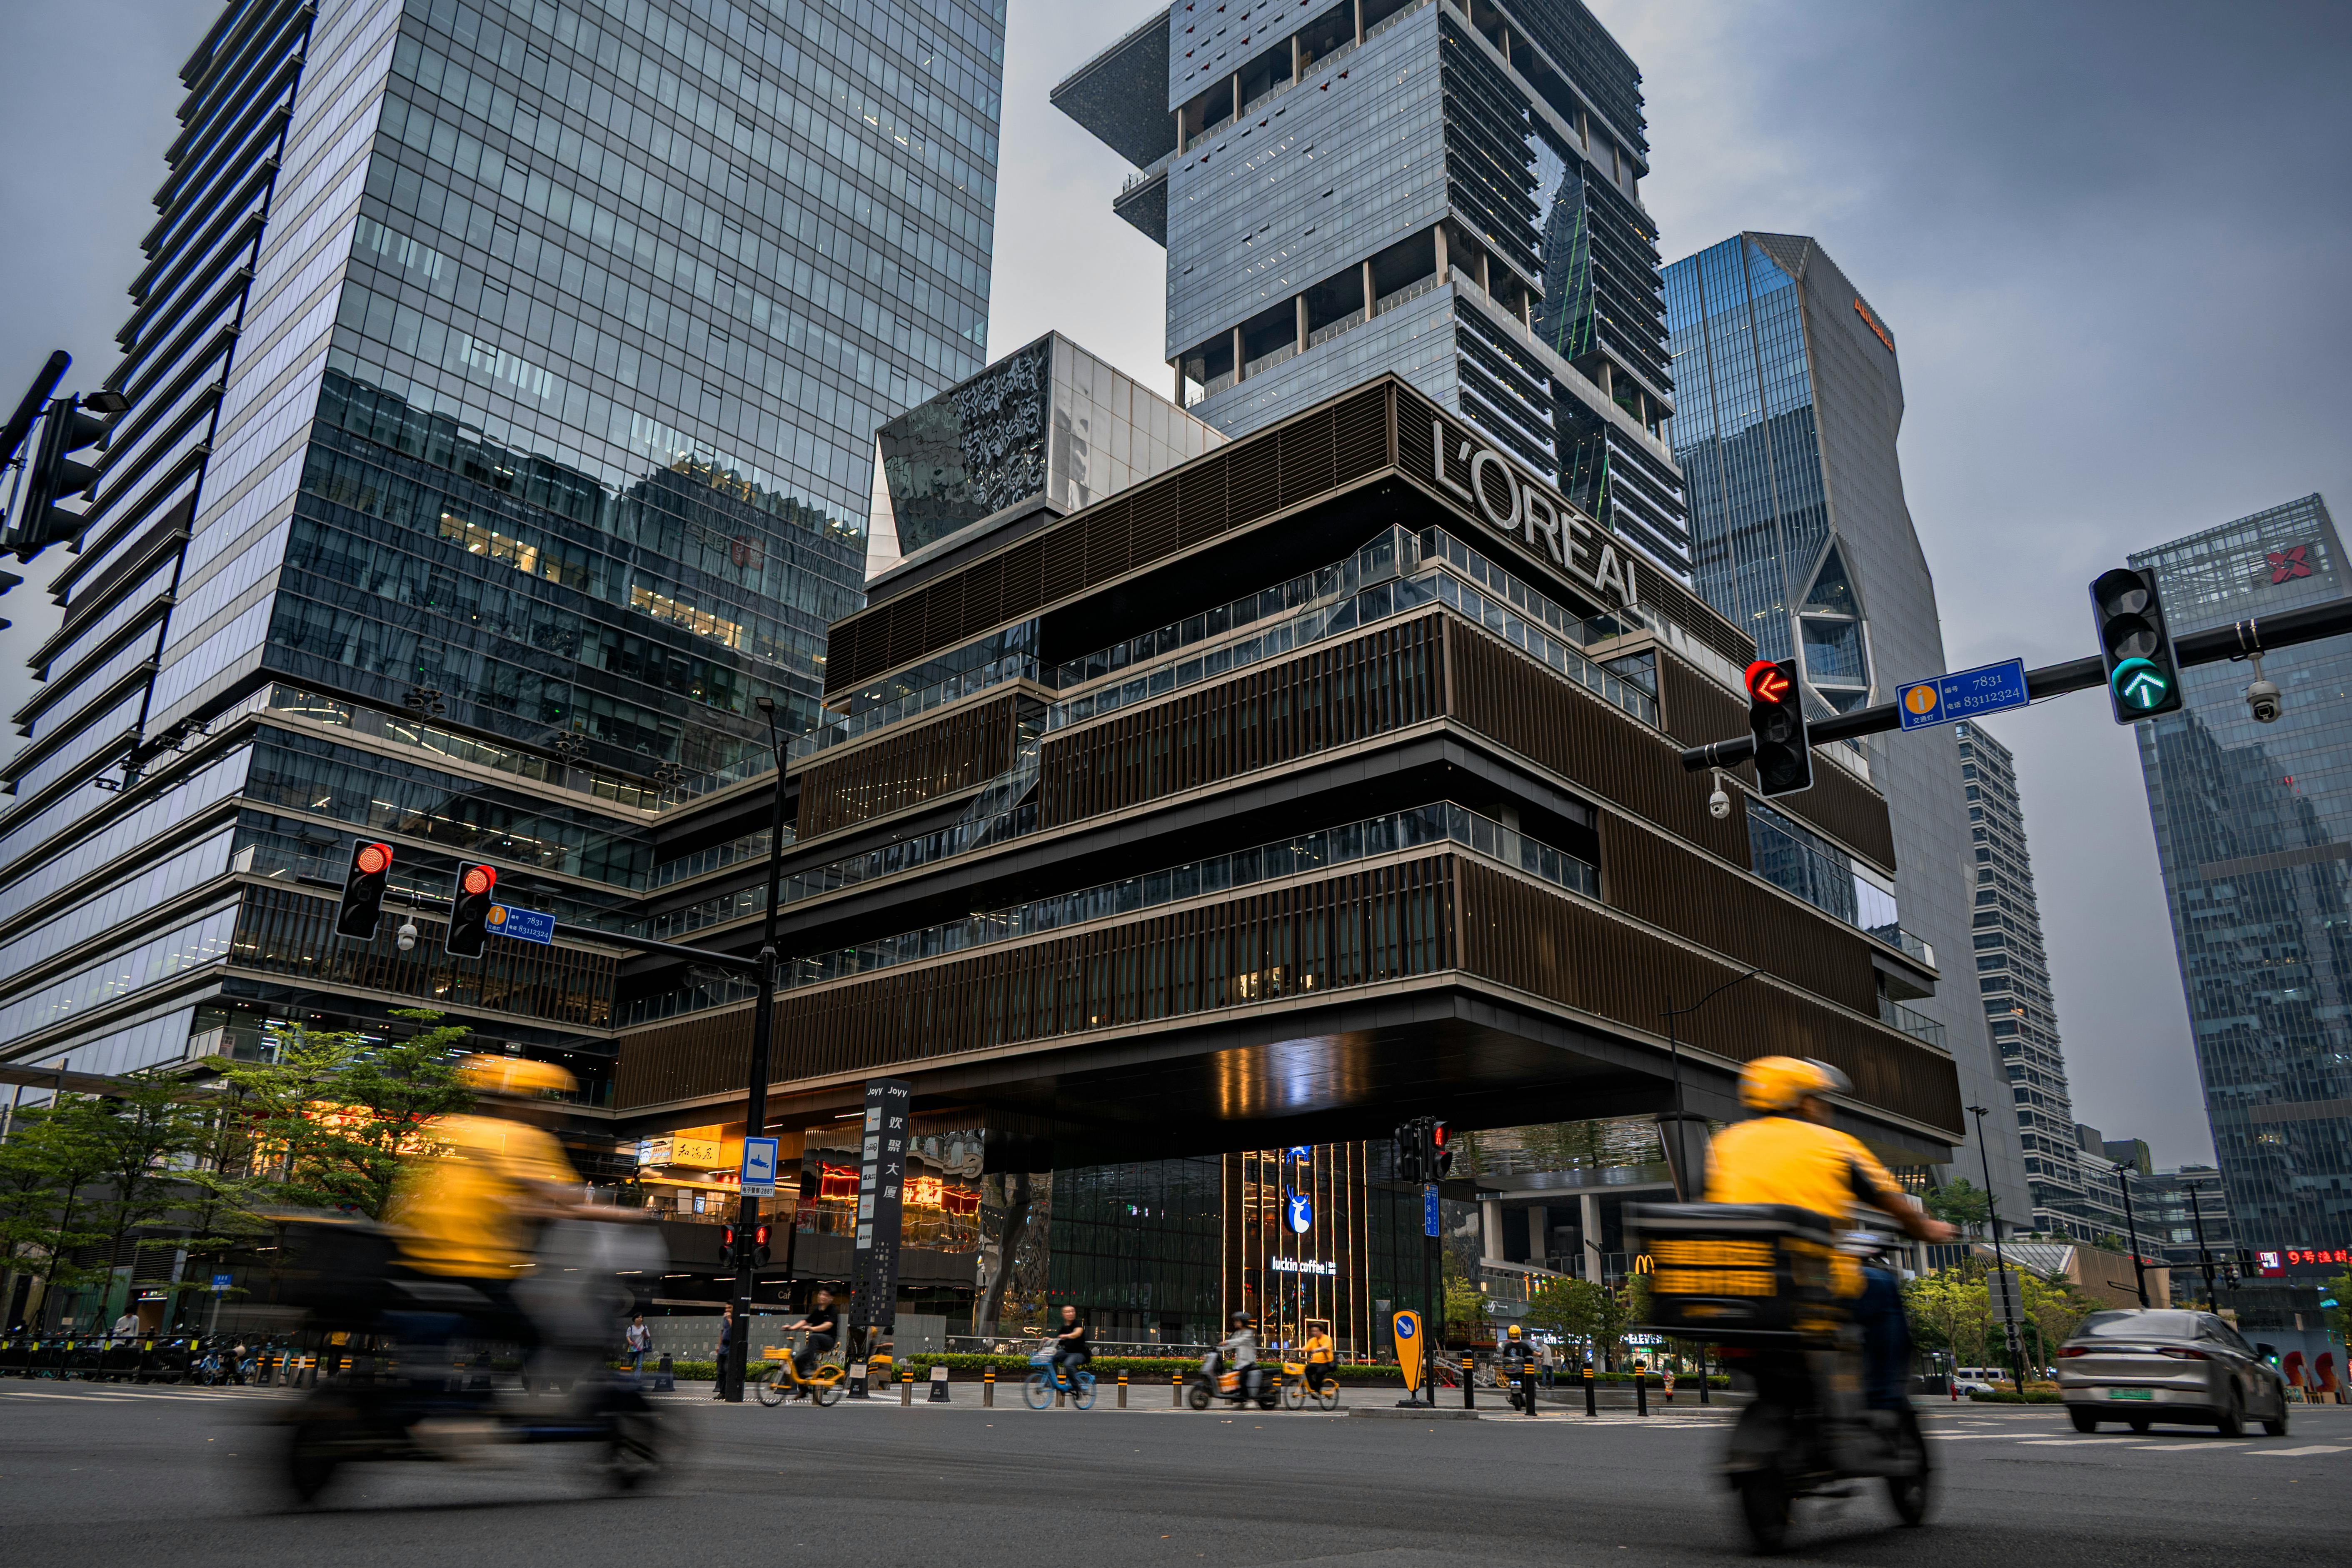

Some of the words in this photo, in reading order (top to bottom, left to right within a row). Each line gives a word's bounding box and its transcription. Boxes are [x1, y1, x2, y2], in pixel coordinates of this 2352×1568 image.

[1854, 298, 1893, 353] Alibaba
[1972, 675, 2002, 690] 7831
[1947, 701, 1961, 710] 电话
[1964, 687, 2020, 707] 83112324
[1913, 714, 1934, 724] 交通灯
[527, 917, 543, 926] 7831
[518, 925, 548, 939] 83112324
[867, 1087, 883, 1096] Joyy
[888, 1086, 907, 1098] Joyy
[883, 1117, 903, 1198] 欢聚大厦
[1272, 1256, 1298, 1271] luckin
[1299, 1260, 1325, 1274] coffee
[778, 1291, 791, 1300] Caf
